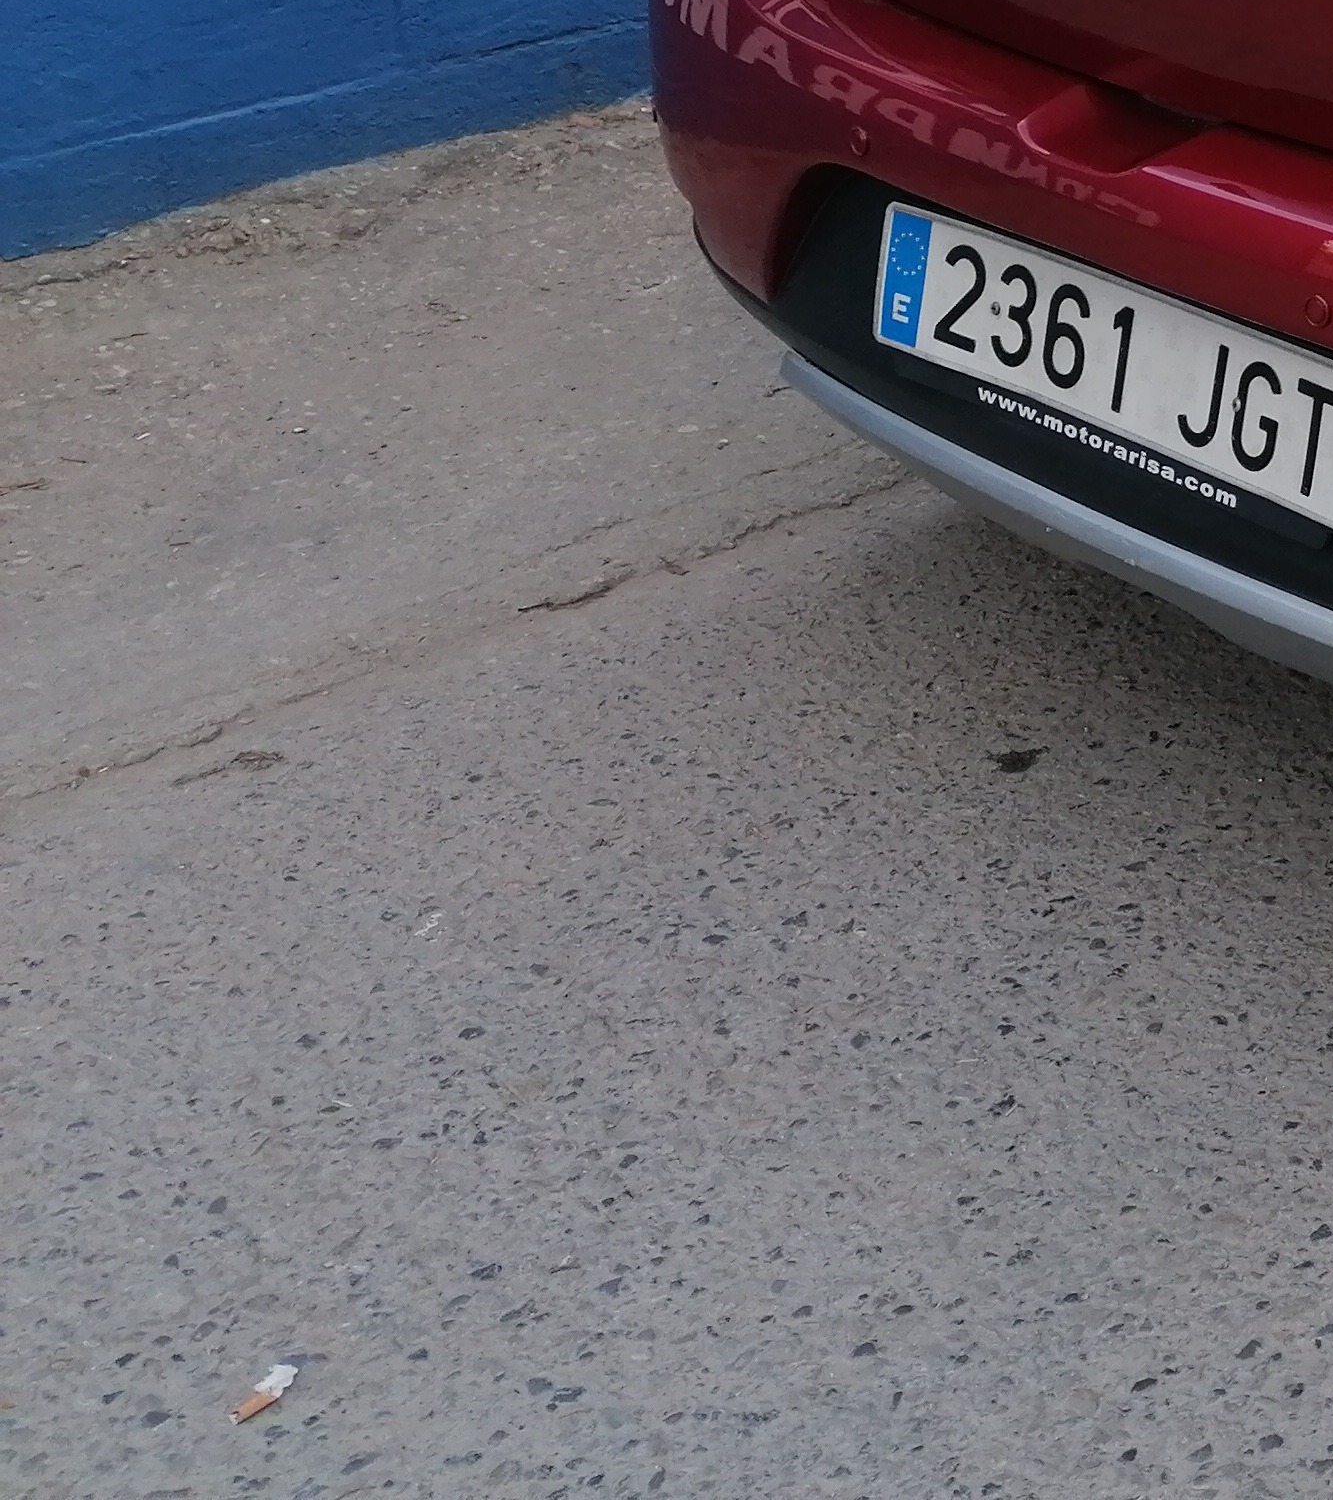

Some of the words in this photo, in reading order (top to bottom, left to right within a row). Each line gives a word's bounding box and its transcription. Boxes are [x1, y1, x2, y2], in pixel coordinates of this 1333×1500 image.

[891, 291, 912, 325] E
[933, 243, 1136, 414] 2361
[977, 385, 1238, 510] www.motorarisa.com
